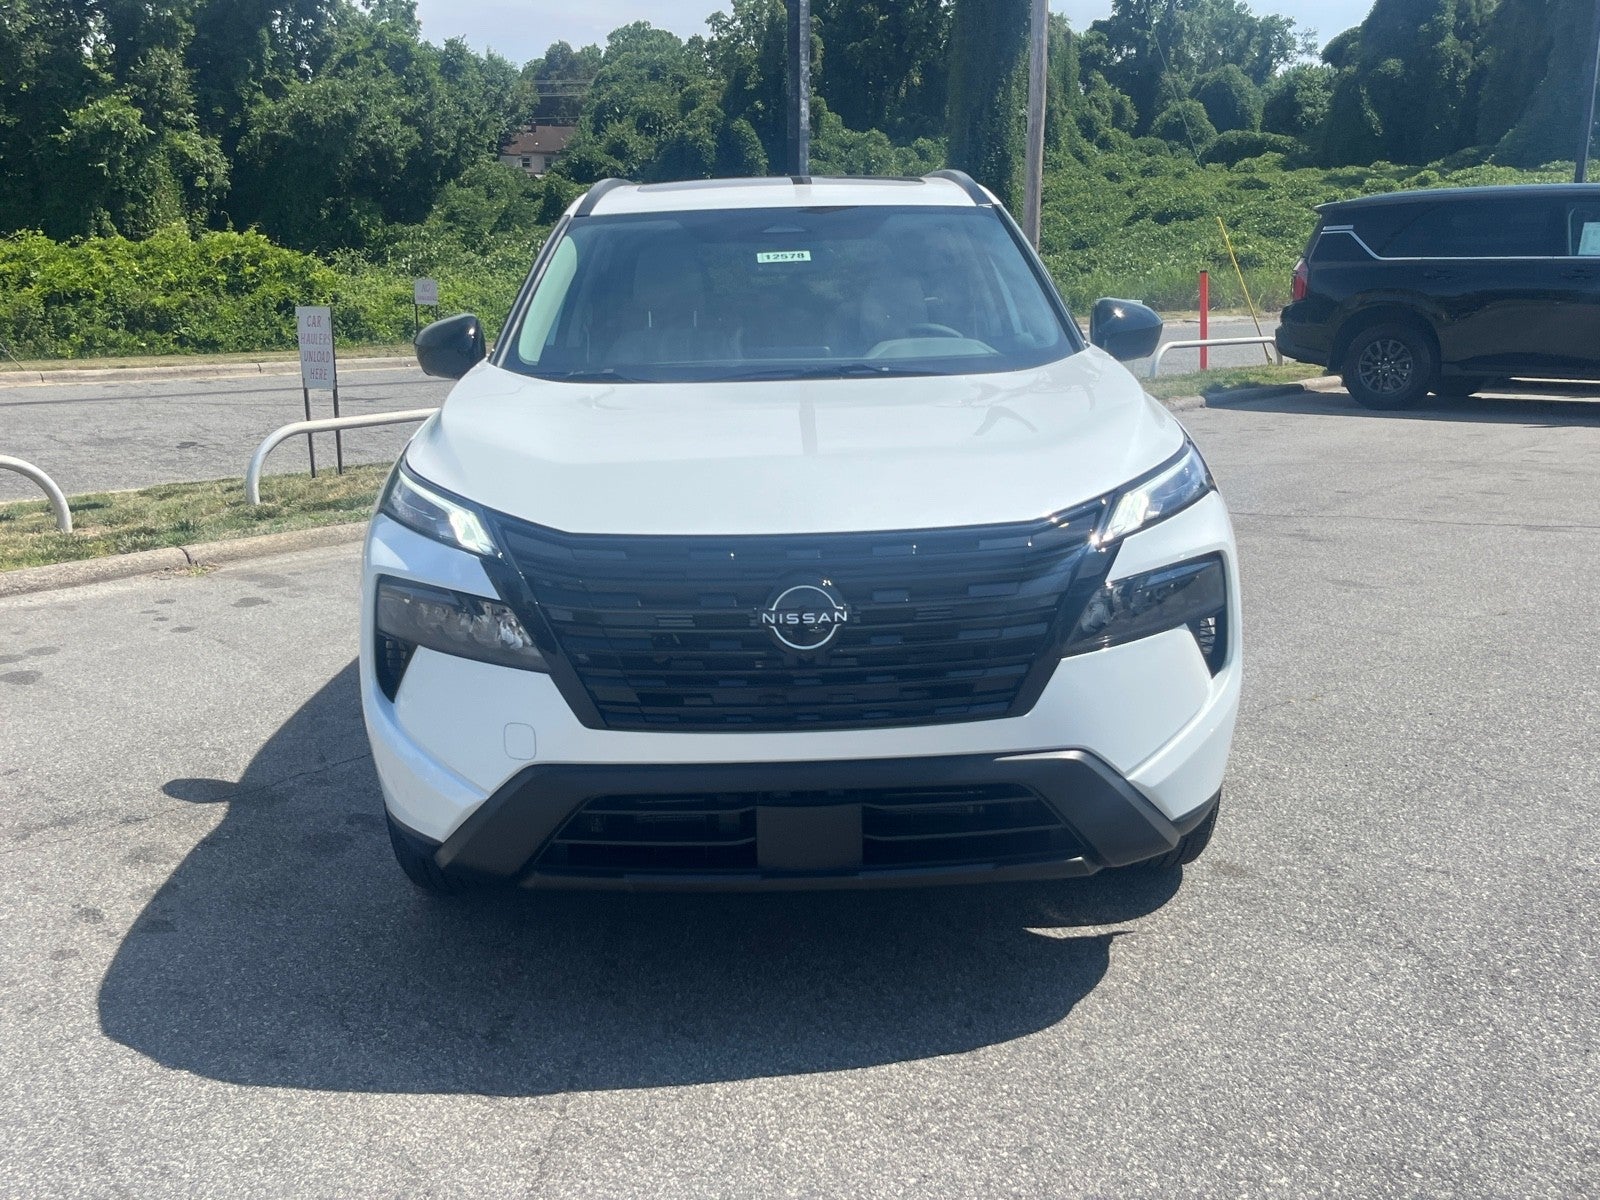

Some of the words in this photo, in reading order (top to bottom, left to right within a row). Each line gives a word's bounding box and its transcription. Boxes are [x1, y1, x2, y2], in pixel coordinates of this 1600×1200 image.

[765, 252, 805, 260] 12578
[306, 315, 321, 328] CAR
[299, 333, 331, 345] HAULERS
[303, 350, 330, 363] UNLOAD
[310, 368, 328, 380] HERE
[762, 611, 847, 624] NISSAN
